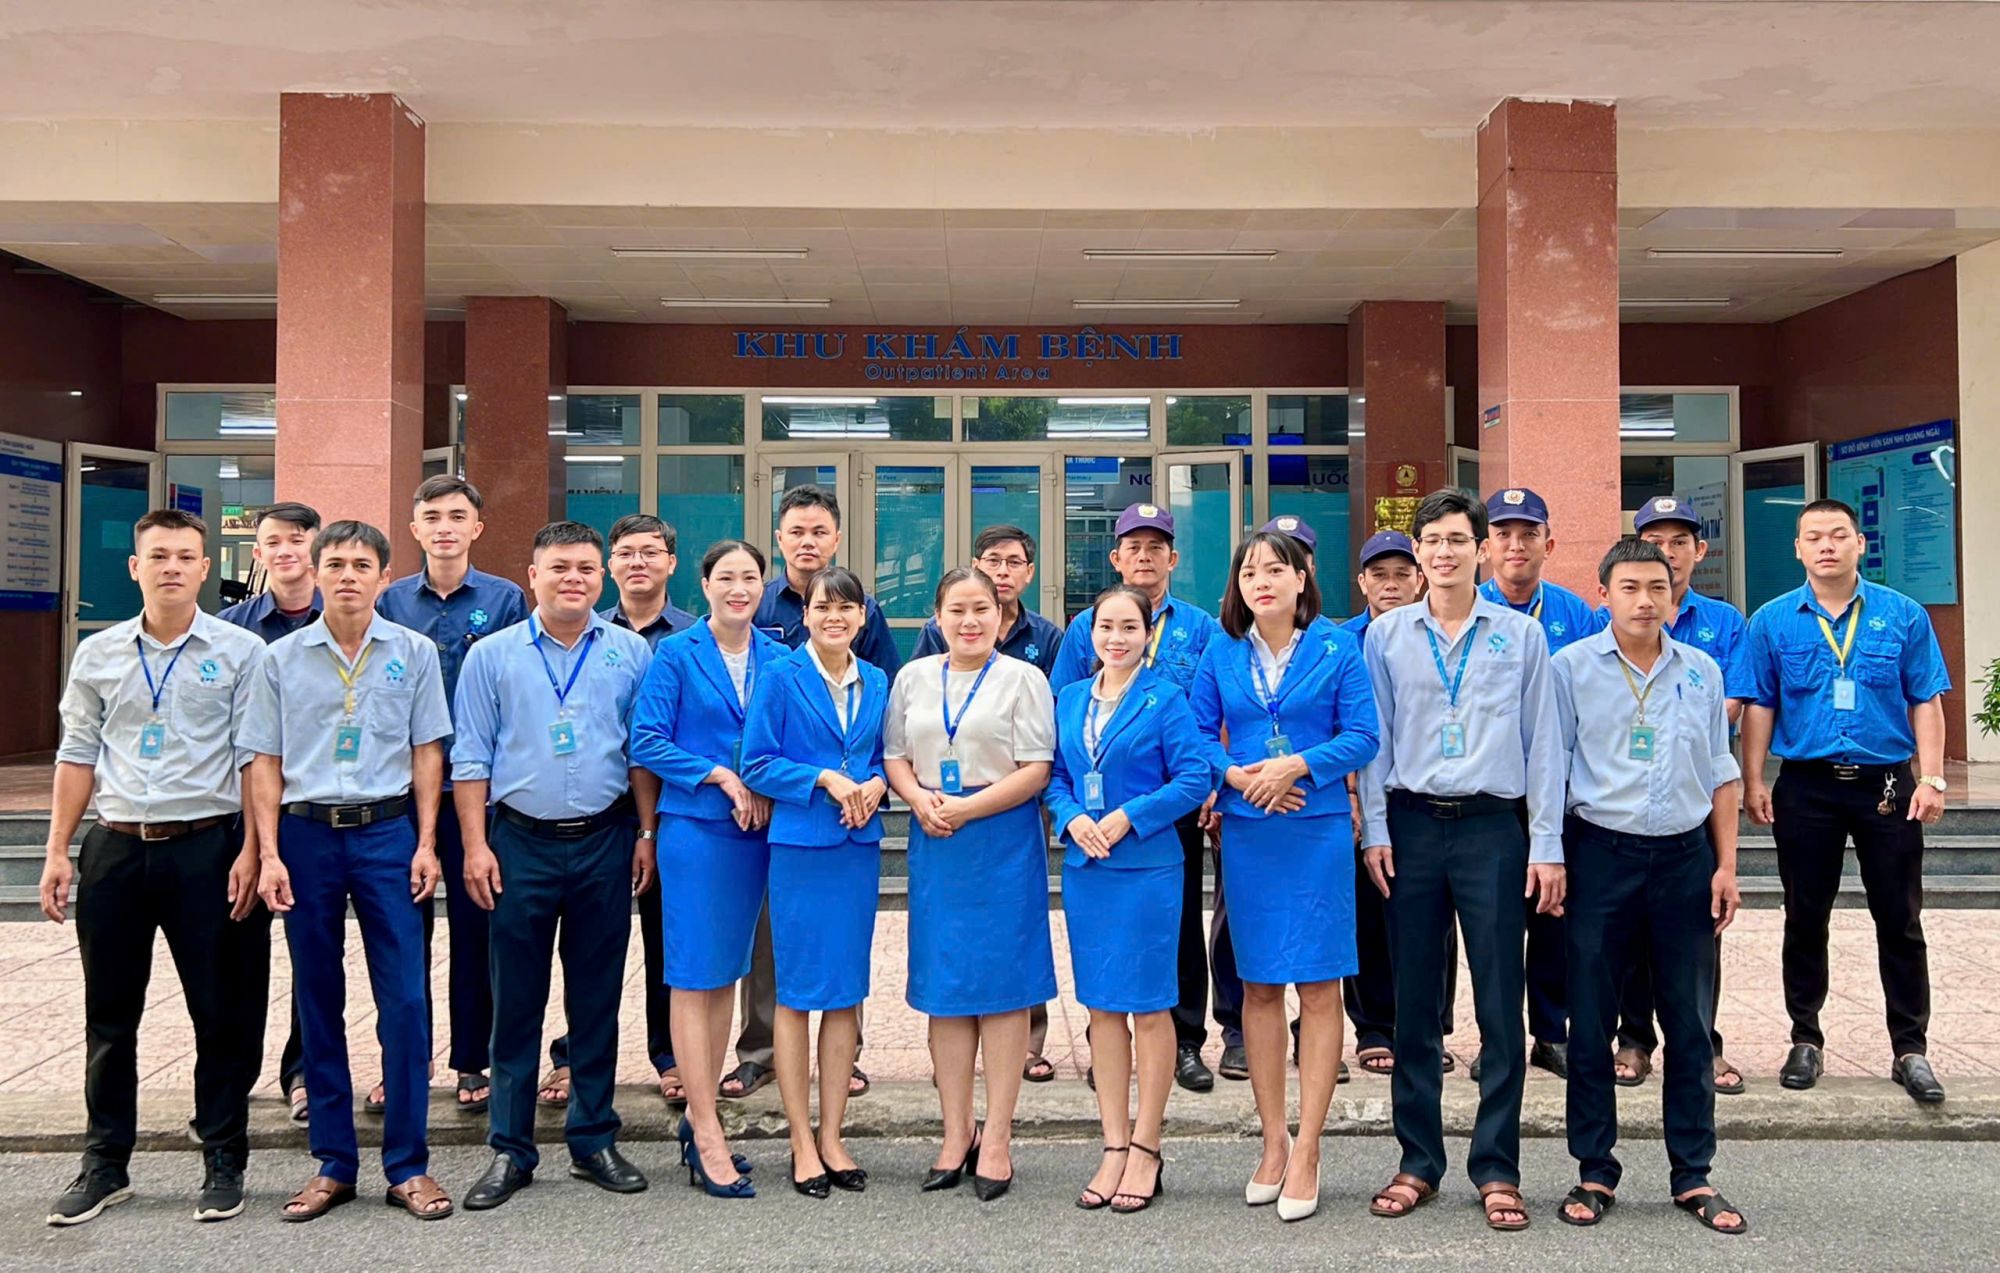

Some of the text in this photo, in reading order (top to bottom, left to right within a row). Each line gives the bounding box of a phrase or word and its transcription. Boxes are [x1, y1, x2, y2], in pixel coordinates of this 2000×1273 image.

[732, 326, 1183, 368] KHU KHÁM BỆNH
[864, 363, 1050, 383] Outpatient Area
